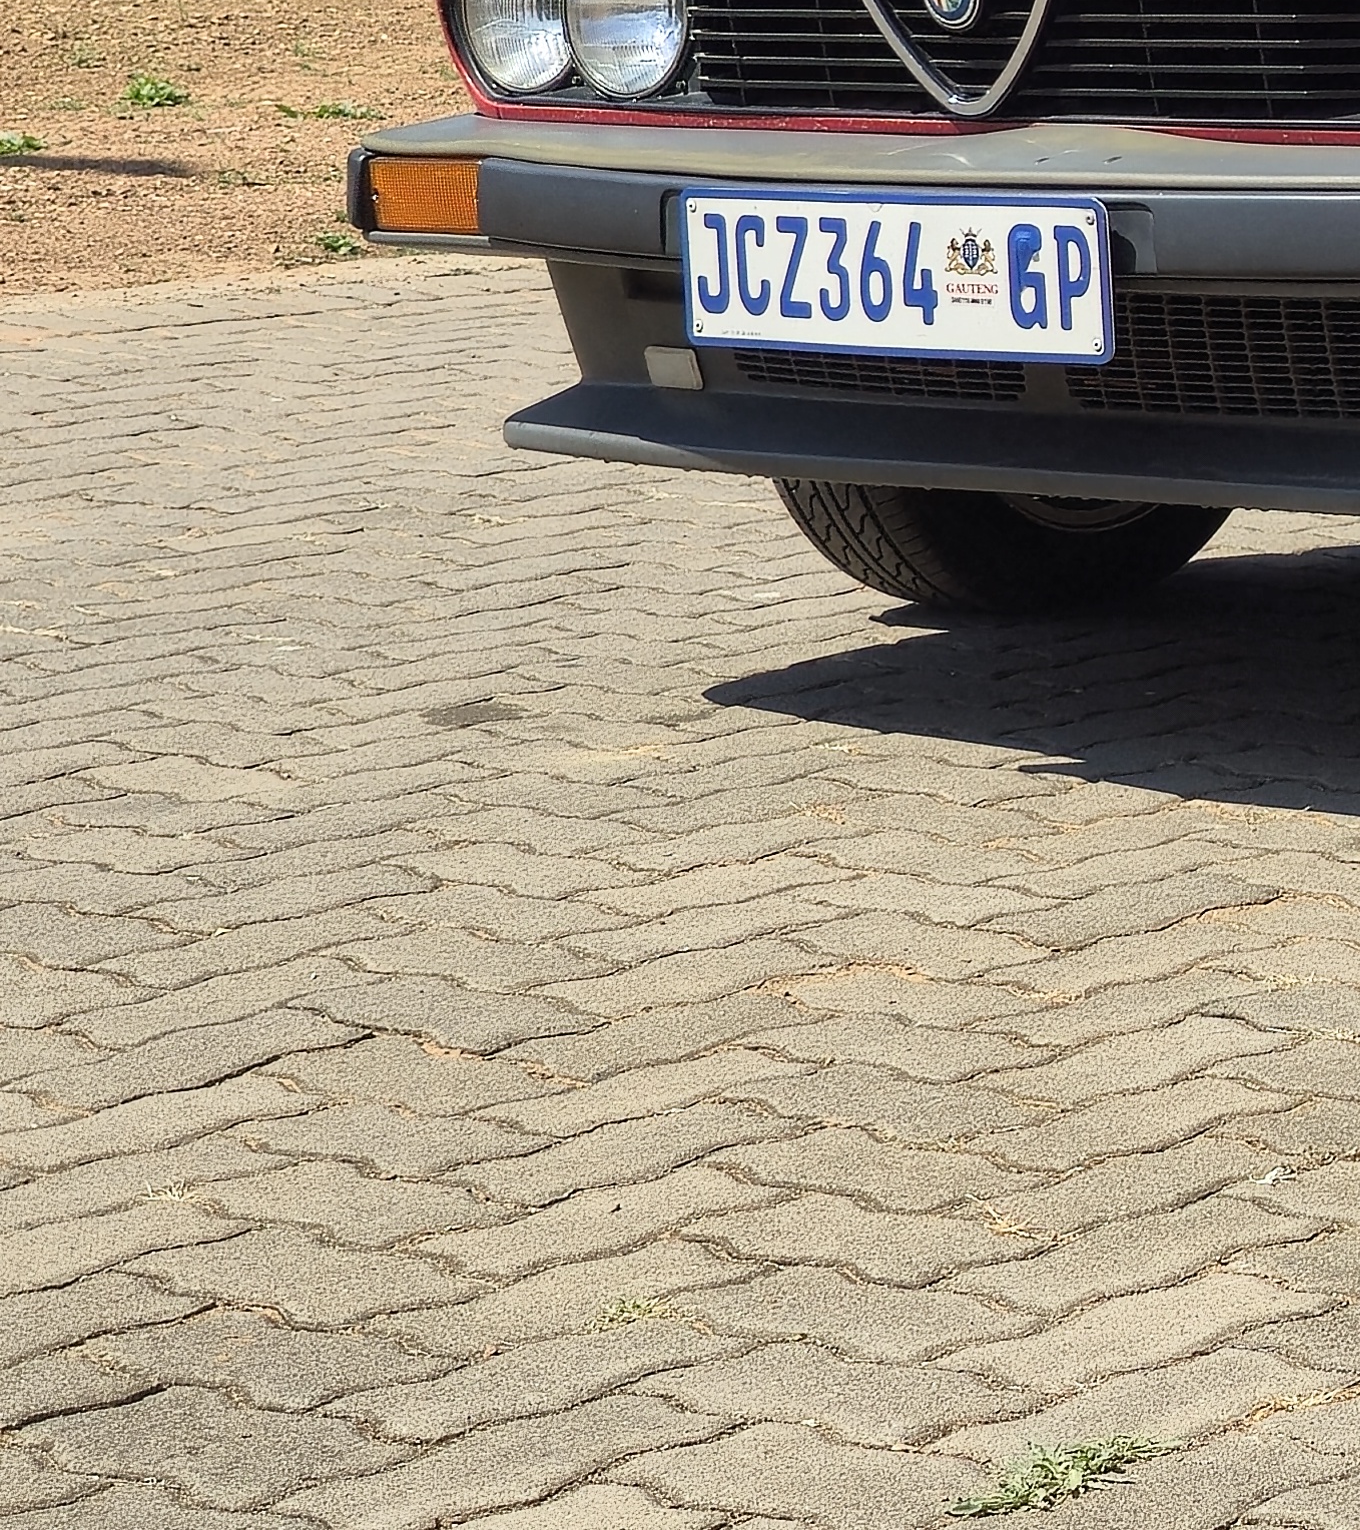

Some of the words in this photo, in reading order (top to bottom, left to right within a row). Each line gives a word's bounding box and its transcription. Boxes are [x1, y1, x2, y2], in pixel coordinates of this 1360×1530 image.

[698, 213, 938, 325] JCZ364
[1007, 223, 1092, 330] GP
[946, 283, 998, 294] GAUTENG
